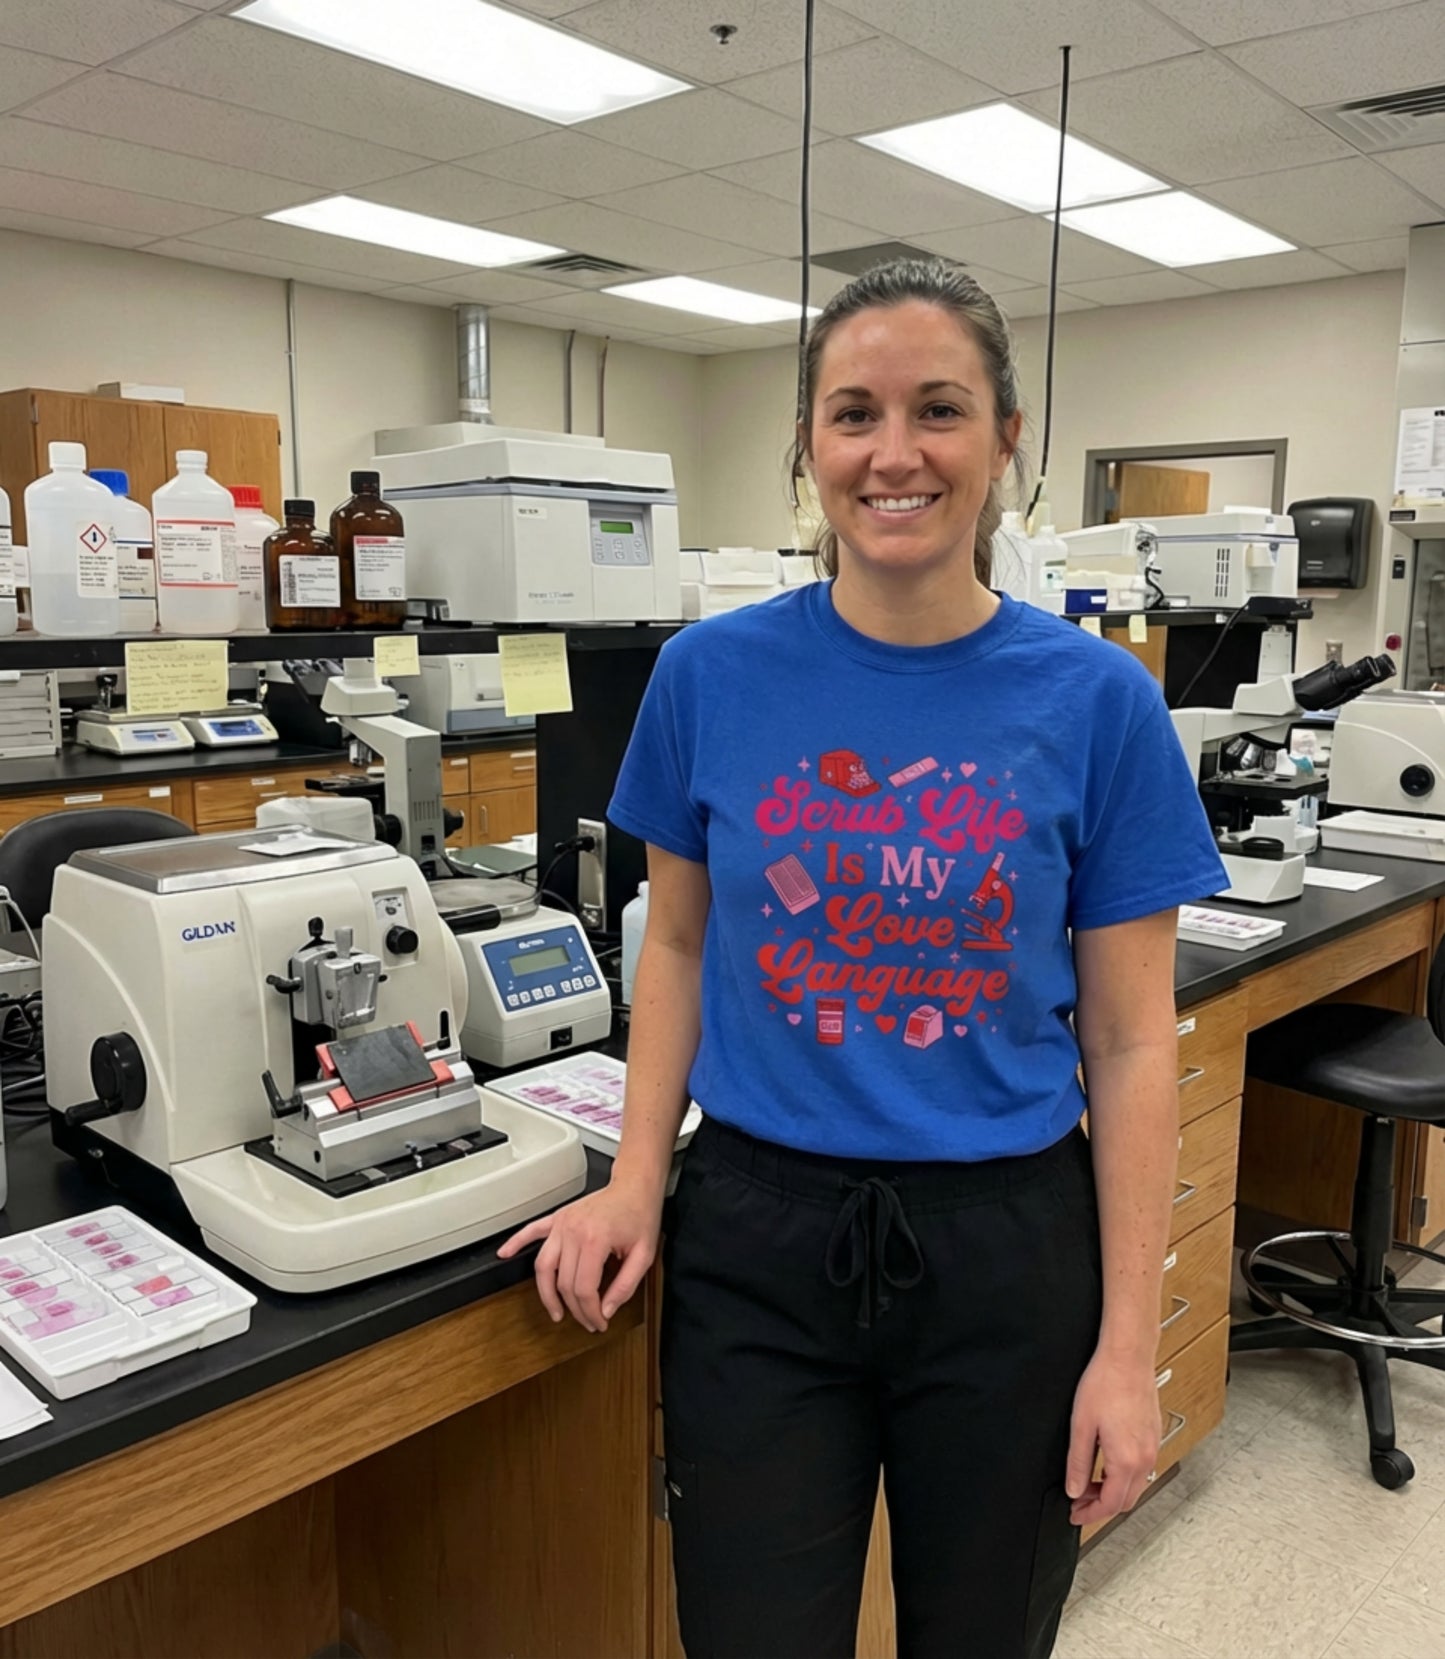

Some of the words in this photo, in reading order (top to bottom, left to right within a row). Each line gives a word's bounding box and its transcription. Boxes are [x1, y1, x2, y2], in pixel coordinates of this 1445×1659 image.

[755, 776, 906, 836] Scrub
[919, 785, 1027, 853] Life
[825, 843, 864, 885] Is
[880, 846, 956, 900] My
[825, 892, 955, 957] Love
[757, 938, 1009, 1016] Language
